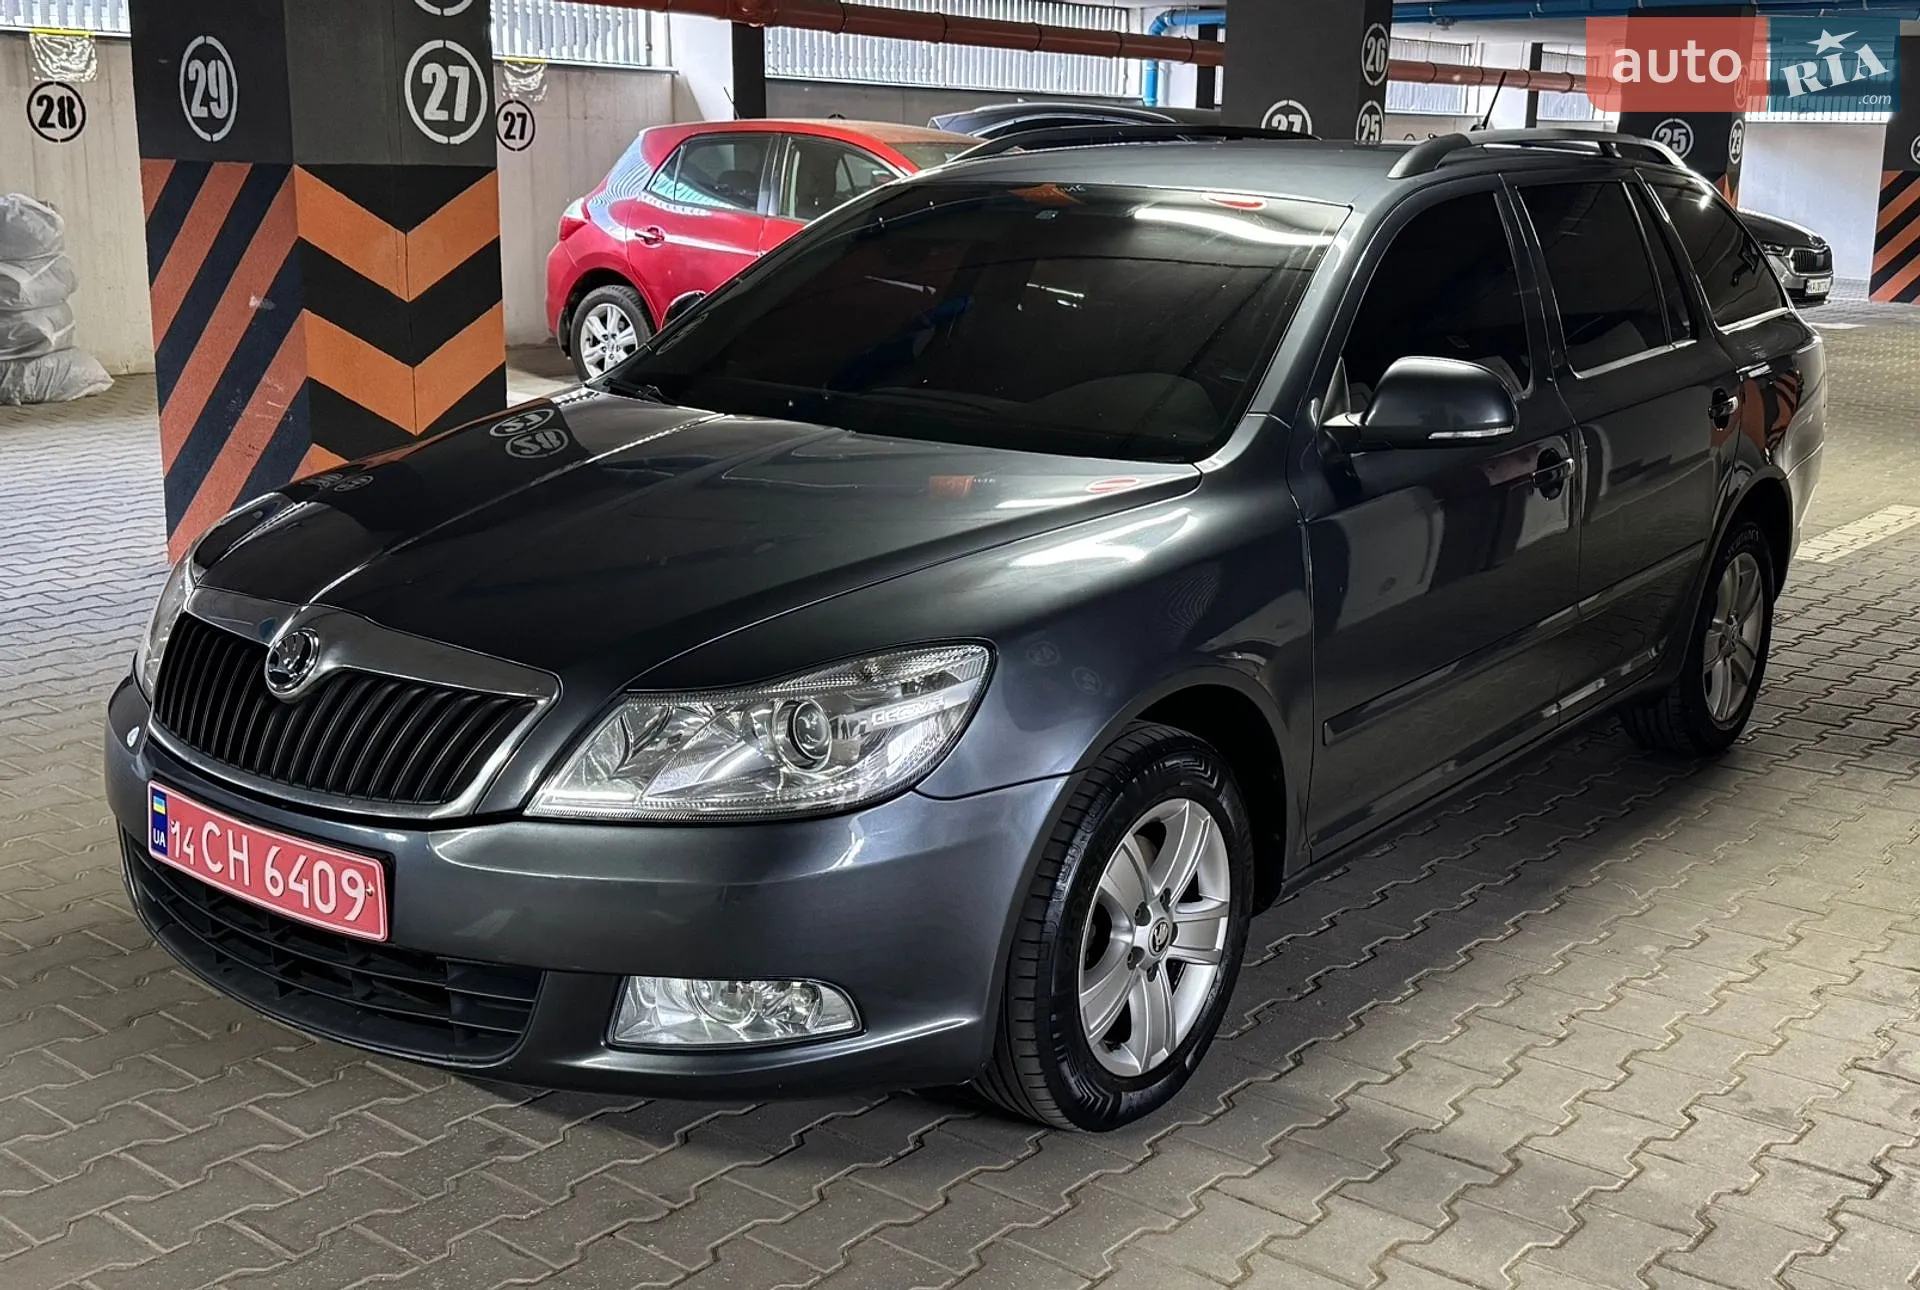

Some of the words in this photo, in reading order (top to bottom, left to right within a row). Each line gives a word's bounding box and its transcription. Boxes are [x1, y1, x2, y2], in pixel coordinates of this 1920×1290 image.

[1364, 36, 1386, 73] 26
[188, 59, 229, 119] 29
[421, 62, 470, 122] 27
[36, 94, 77, 130] 28
[503, 111, 528, 140] 27
[1360, 114, 1380, 143] 25
[1658, 128, 1688, 153] 25
[153, 828, 166, 848] UA
[263, 845, 367, 922] 6409
